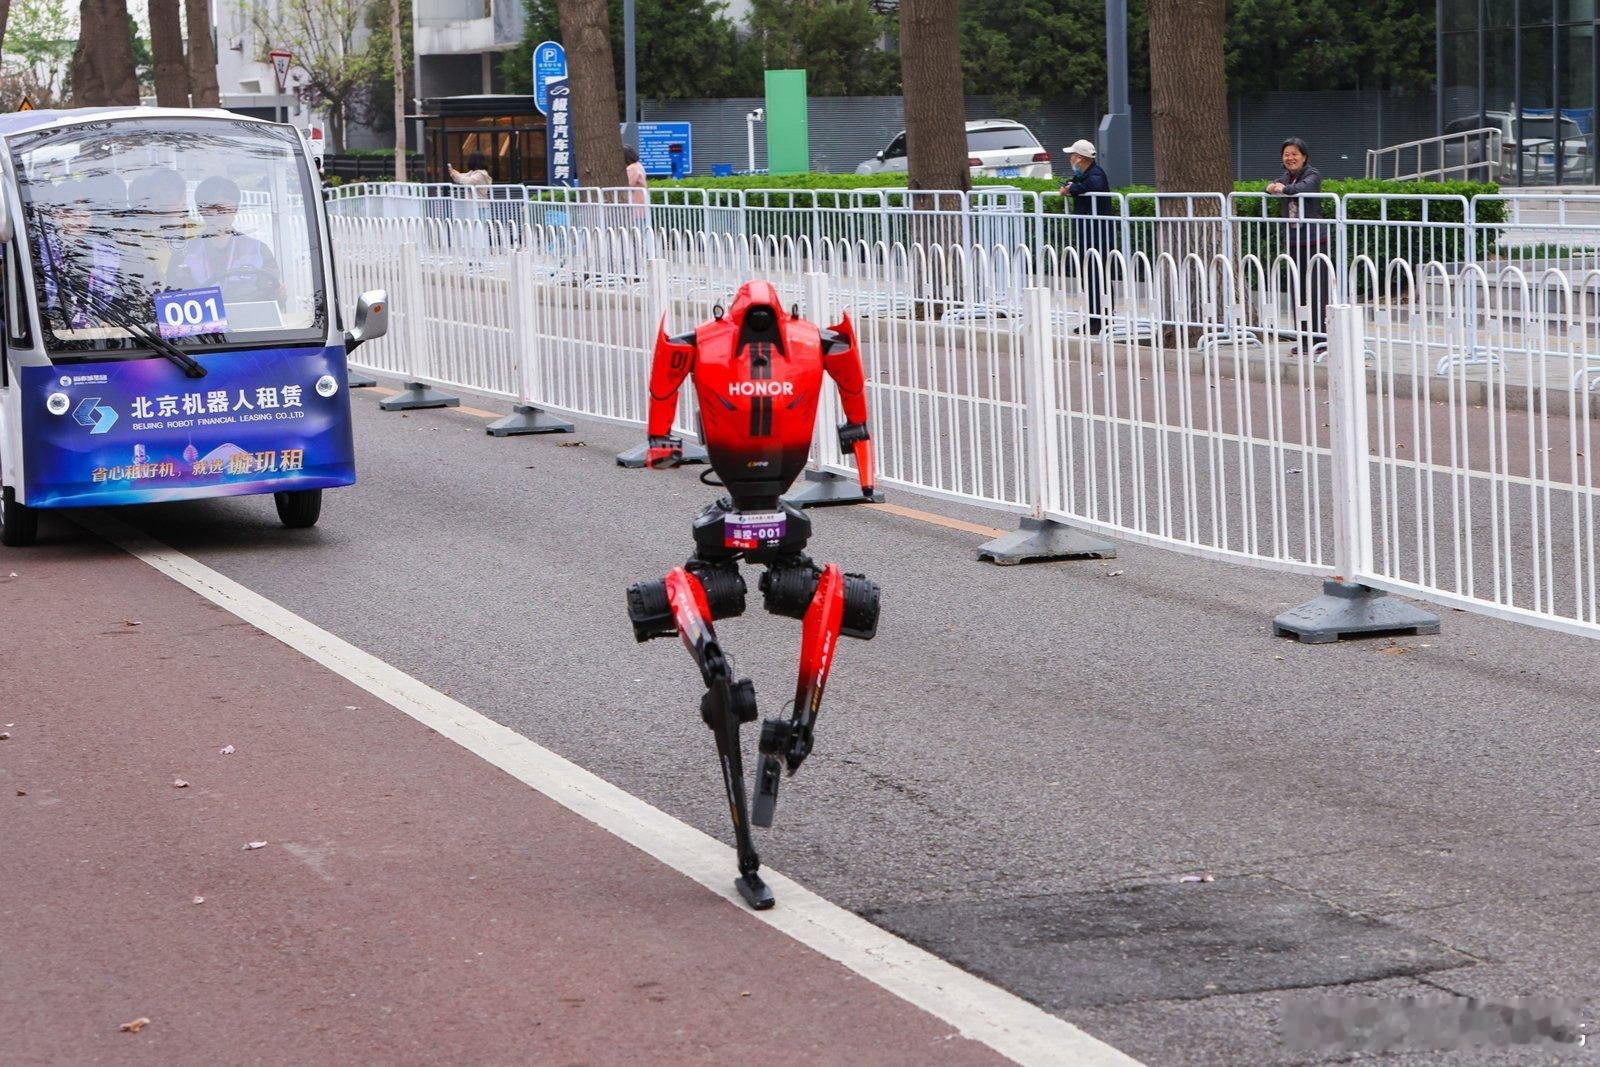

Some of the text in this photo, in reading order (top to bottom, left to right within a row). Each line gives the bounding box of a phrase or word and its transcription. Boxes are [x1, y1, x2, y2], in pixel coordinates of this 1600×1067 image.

[165, 298, 219, 326] 001
[729, 381, 794, 396] HONOR
[131, 385, 303, 418] 北京机器人租赁
[132, 421, 164, 430] BEIJING
[167, 419, 195, 428] ROBOT
[197, 415, 237, 426] FINANCIAL
[240, 412, 273, 422] LEASING
